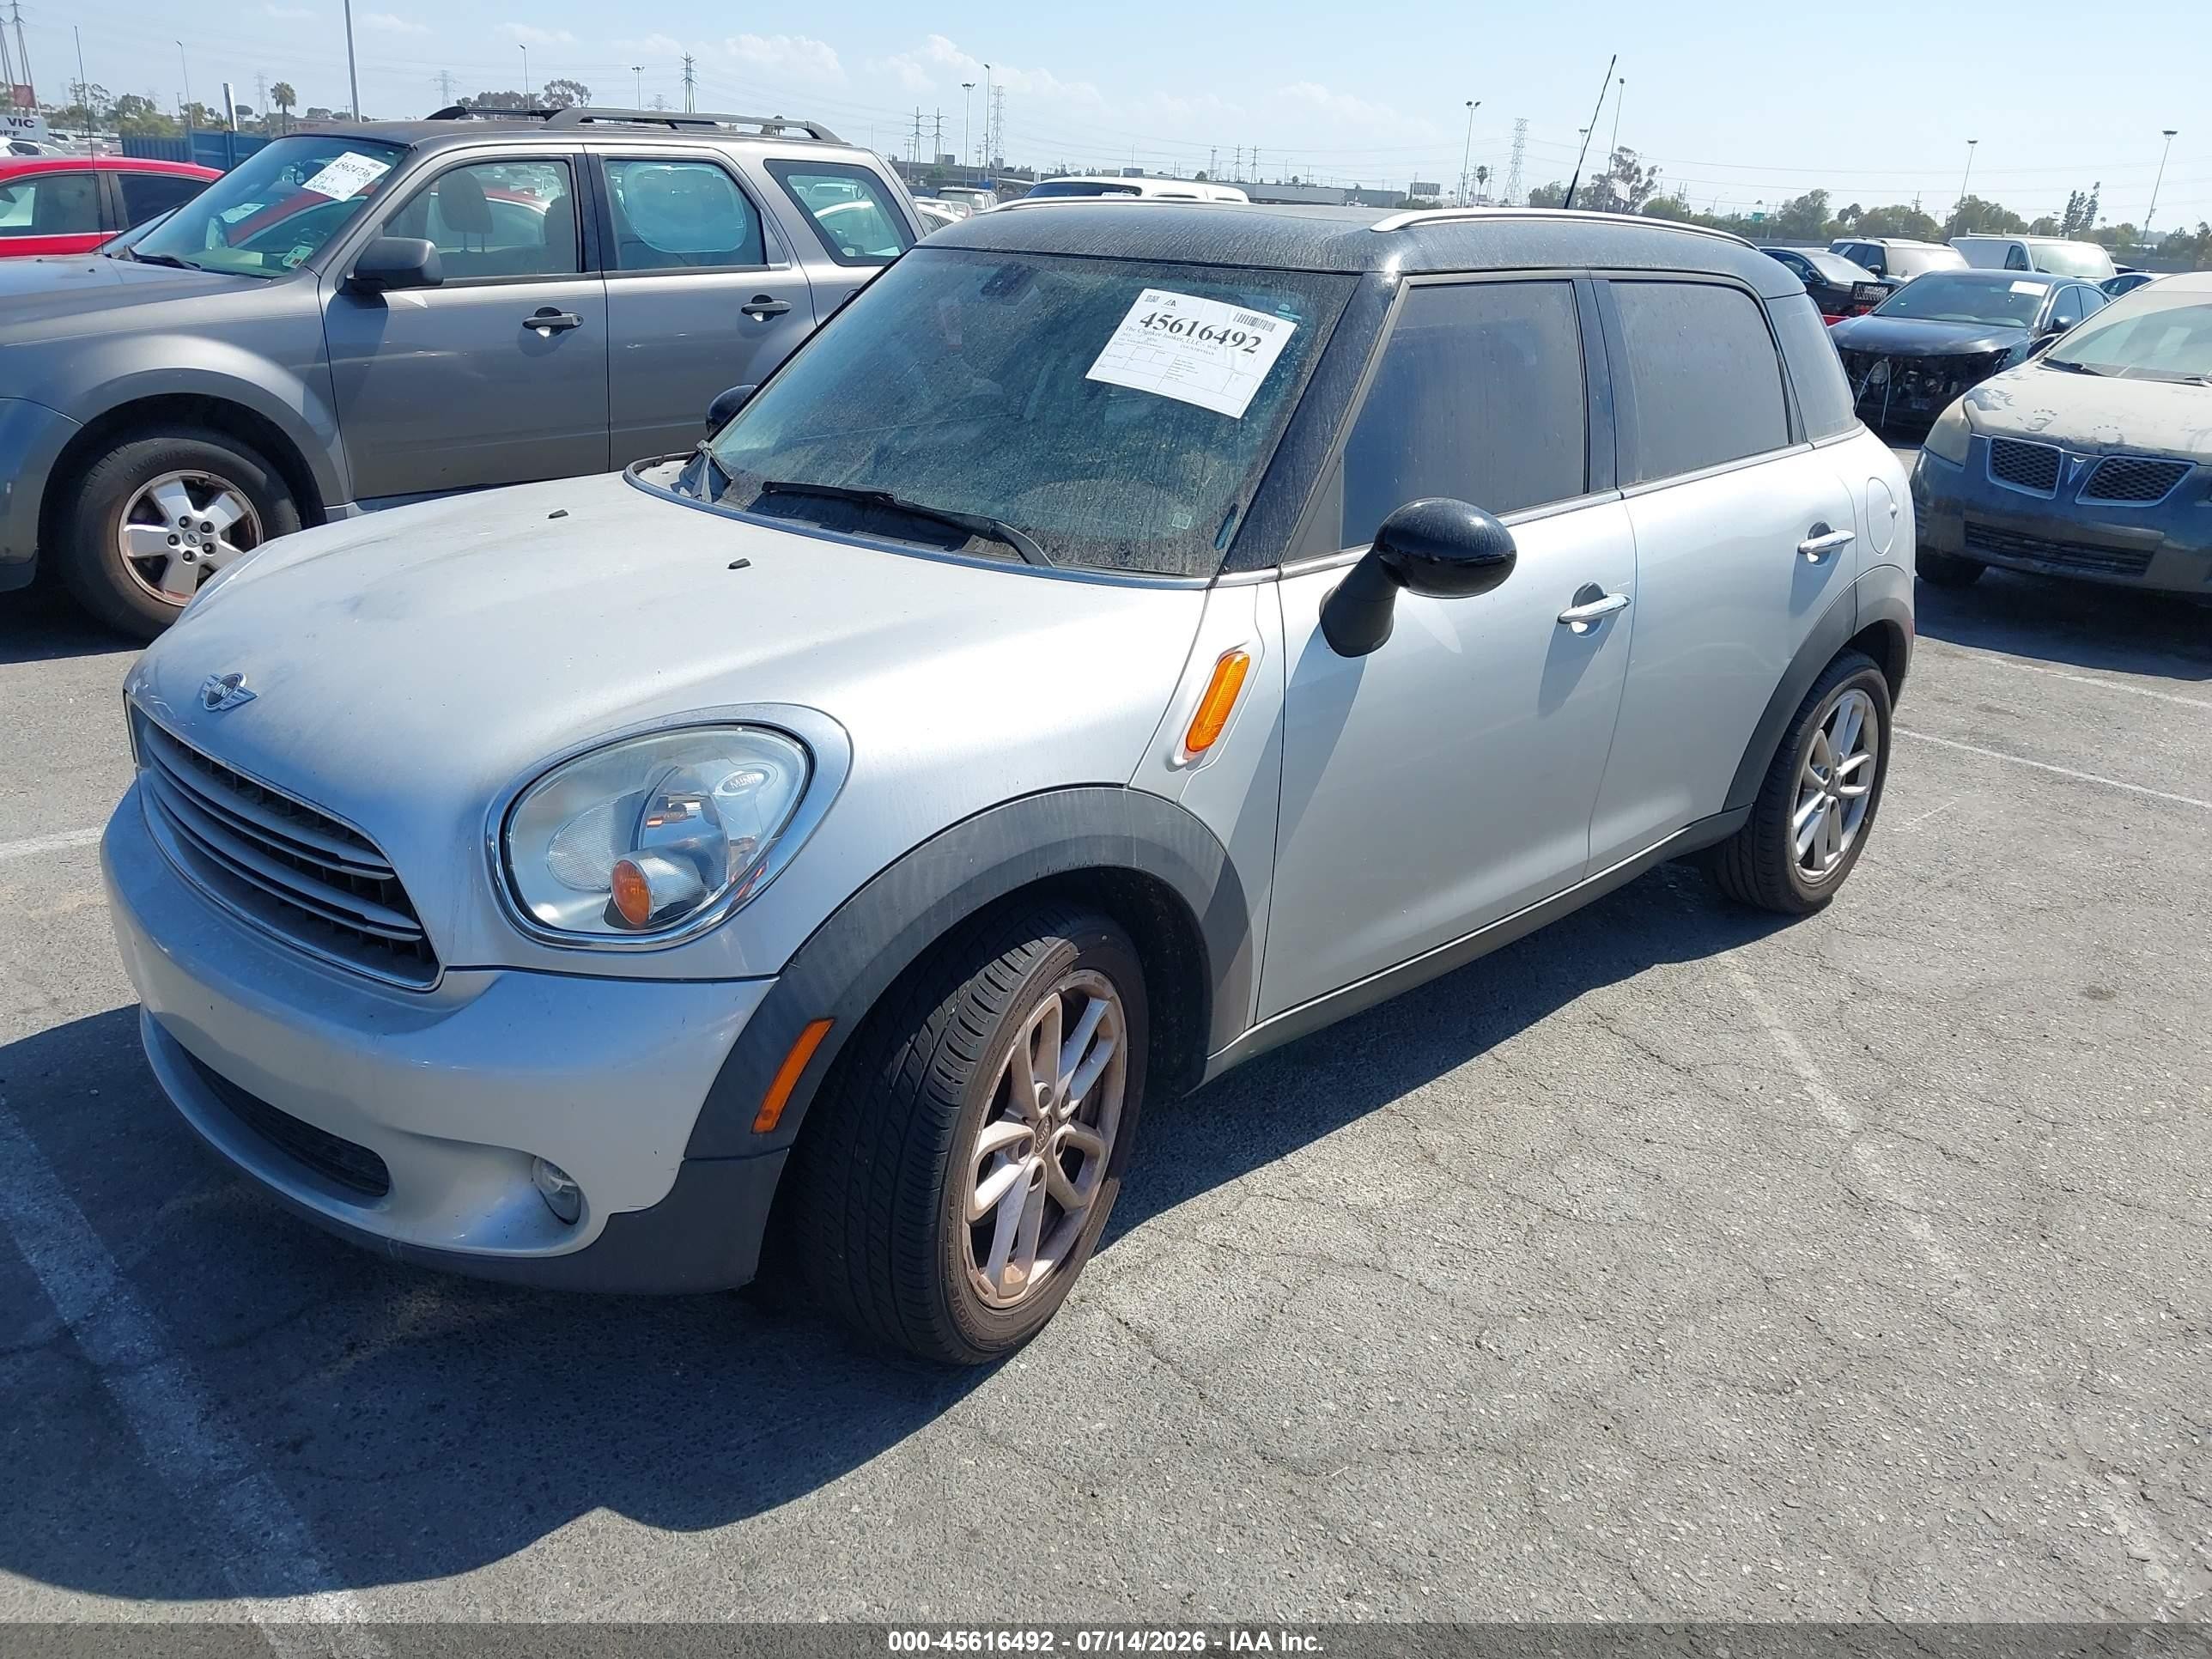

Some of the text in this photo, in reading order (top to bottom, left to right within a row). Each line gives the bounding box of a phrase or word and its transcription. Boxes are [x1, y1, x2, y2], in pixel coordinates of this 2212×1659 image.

[7, 117, 35, 128] VIC
[1139, 312, 1262, 354] 45616492
[212, 682, 234, 697] MINI
[730, 775, 757, 789] MINI
[1036, 1119, 1049, 1149] MINI
